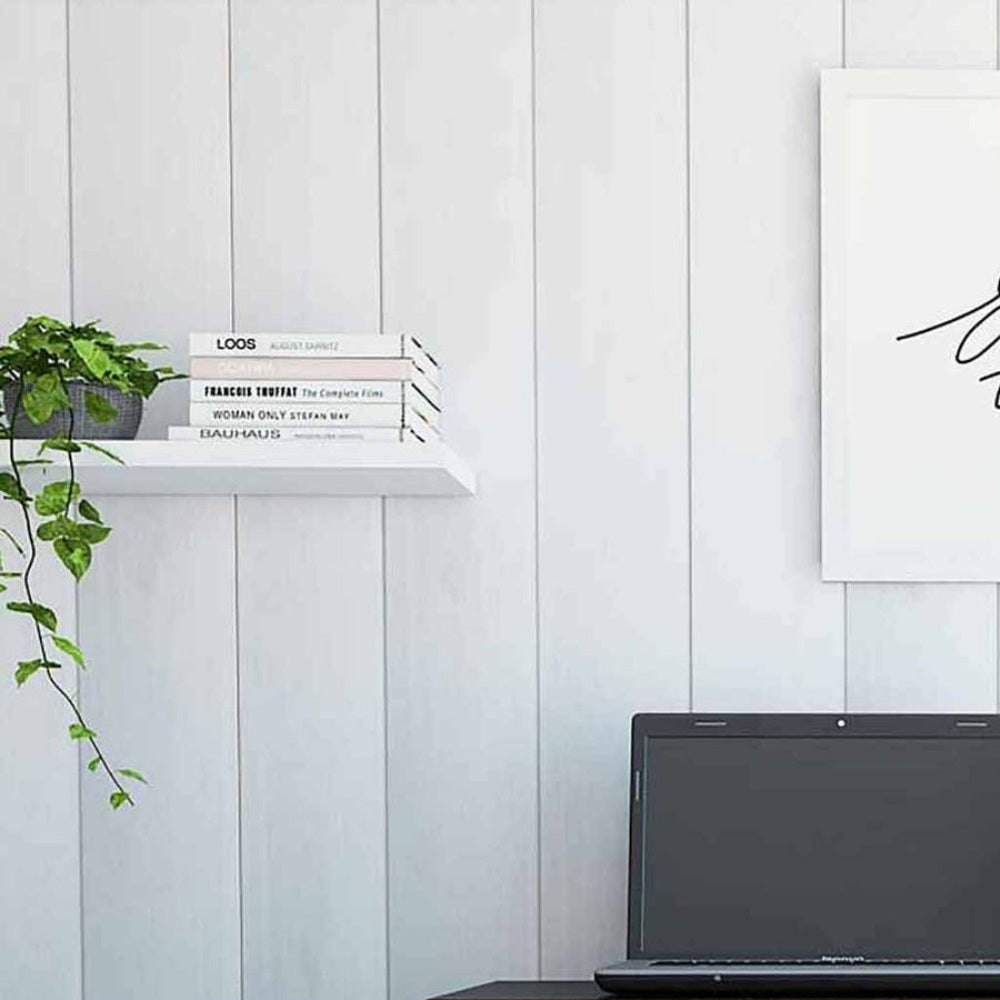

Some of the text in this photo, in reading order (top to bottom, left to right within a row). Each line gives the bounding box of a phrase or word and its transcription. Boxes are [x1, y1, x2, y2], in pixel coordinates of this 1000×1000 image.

[217, 338, 256, 350] LOOS
[204, 386, 252, 397] FRANCOIS
[303, 388, 317, 398] The
[320, 389, 359, 399] Complete
[213, 410, 254, 420] WOMAN
[258, 410, 286, 420] ONLY
[290, 411, 327, 420] STEFAN
[200, 429, 280, 439] BAUHAUS
